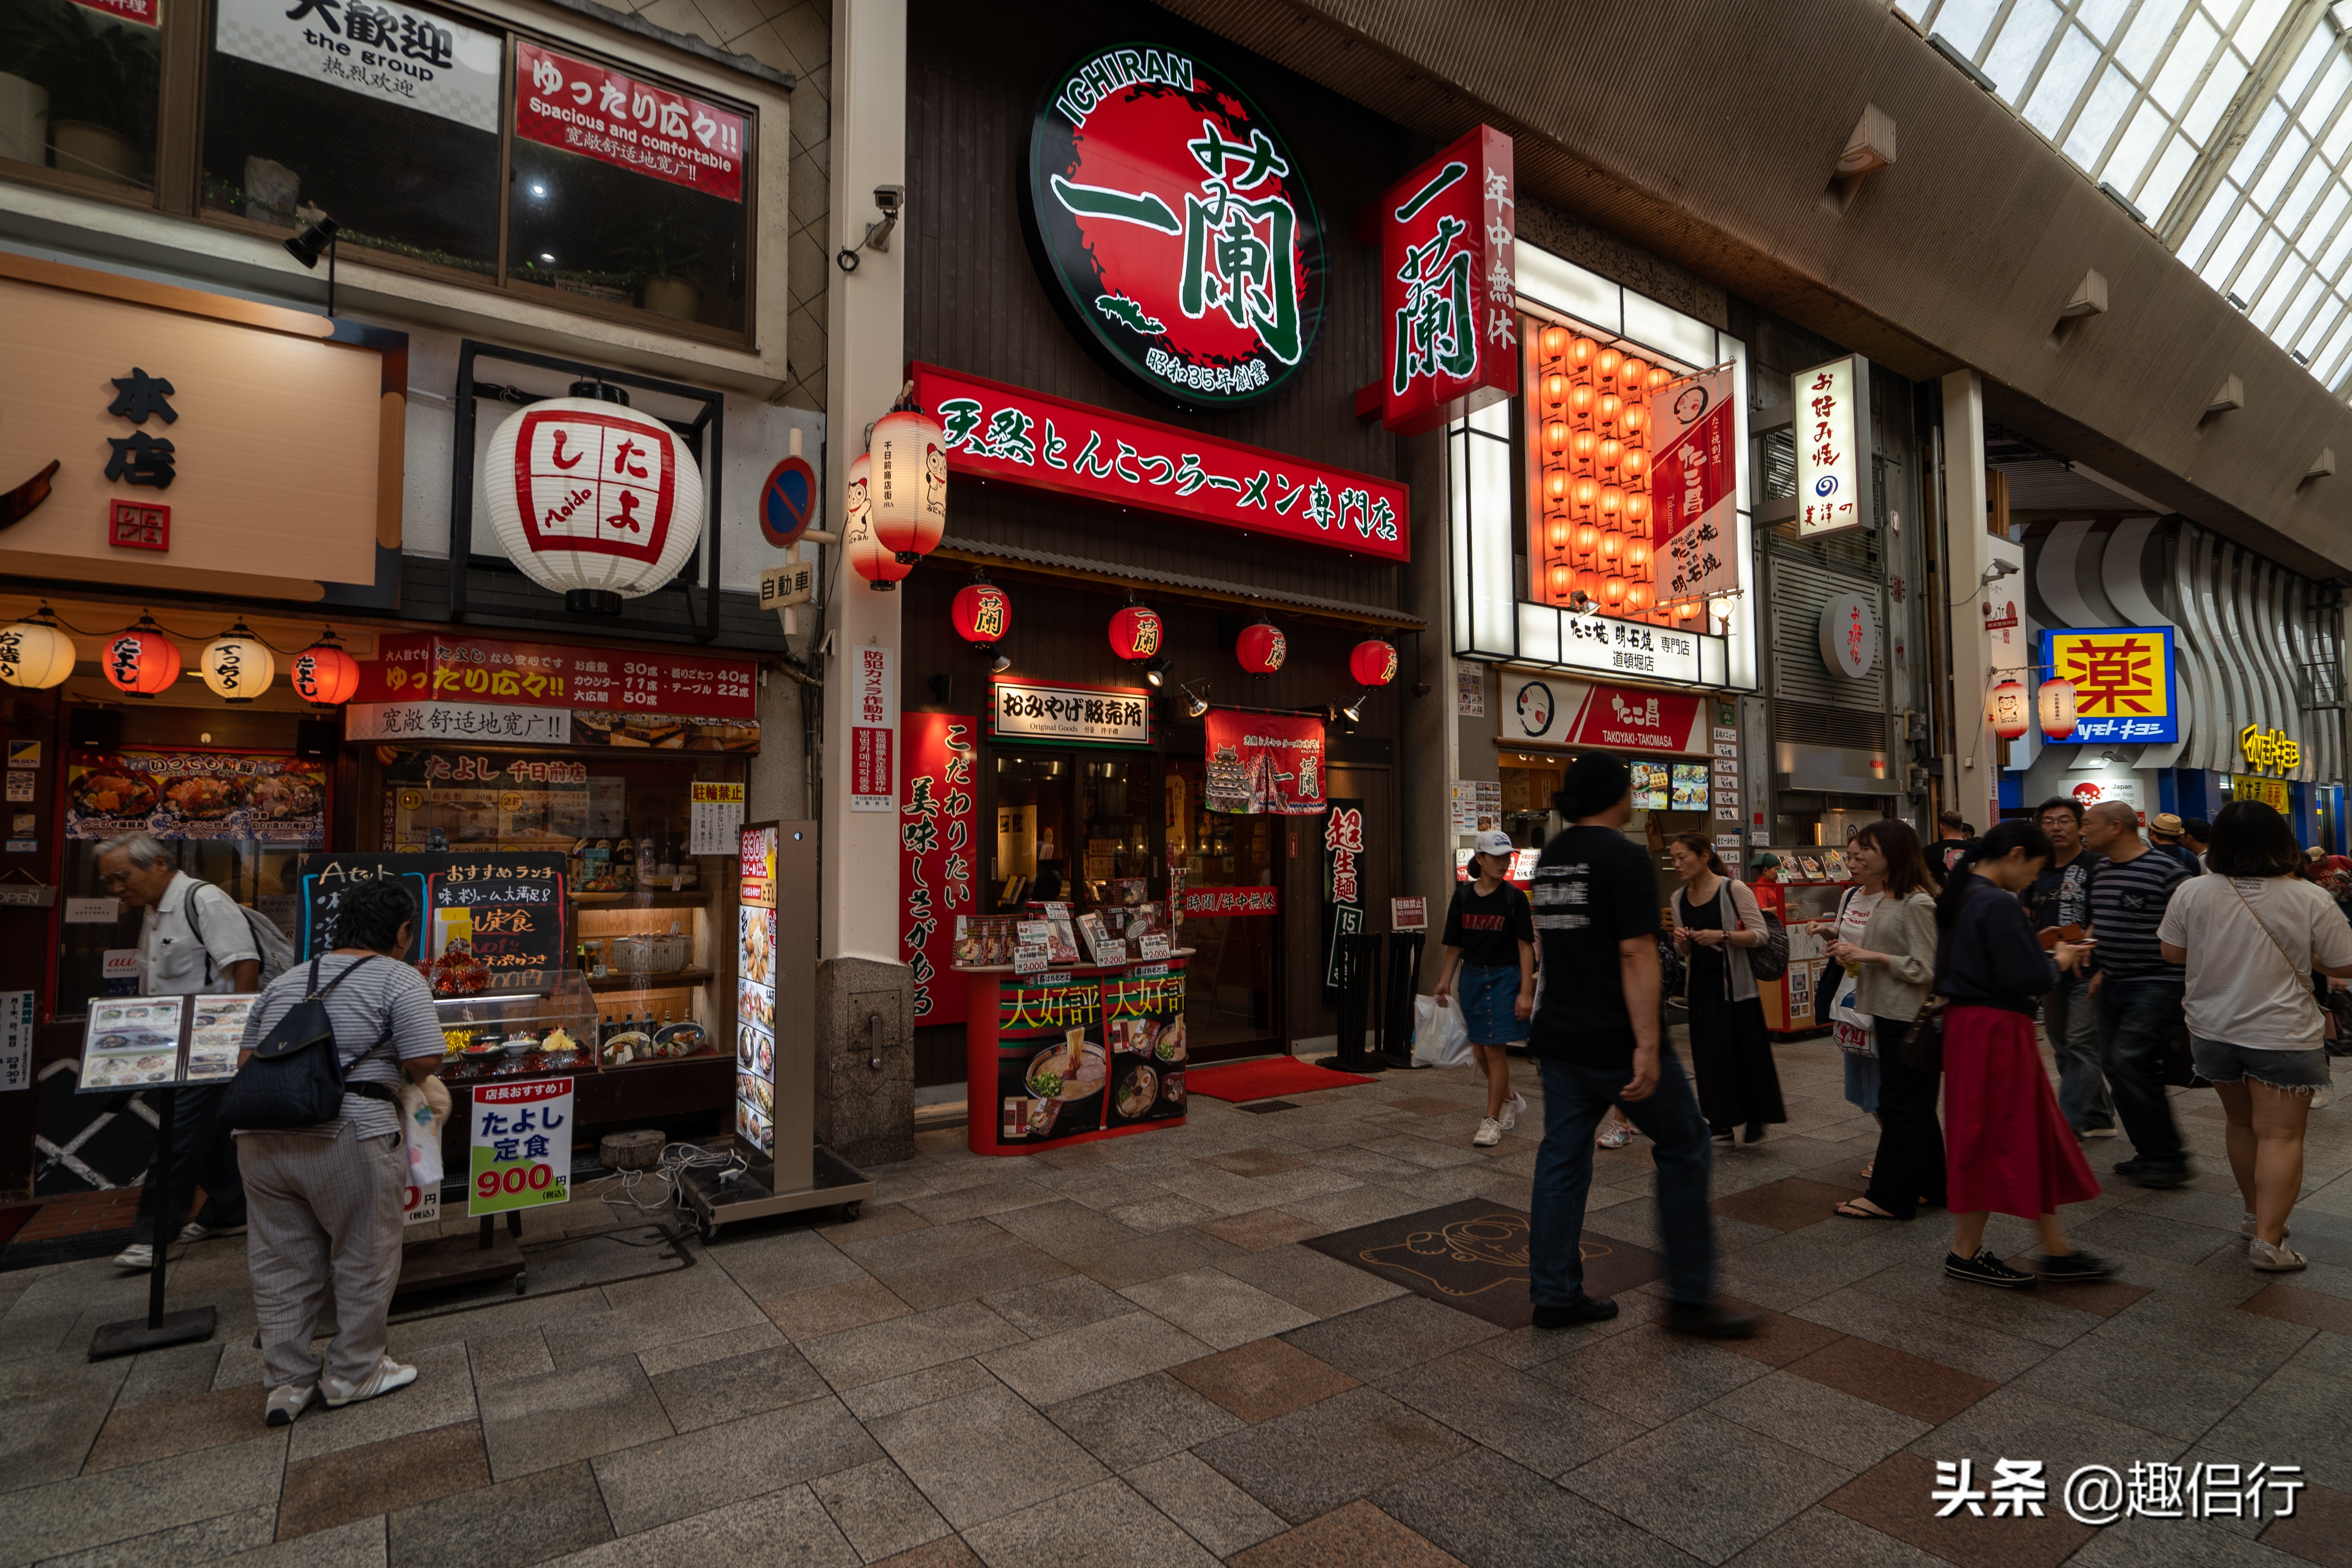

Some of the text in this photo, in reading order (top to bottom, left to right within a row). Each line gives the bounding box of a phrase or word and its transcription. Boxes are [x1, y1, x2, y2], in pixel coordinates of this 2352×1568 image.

[303, 28, 434, 81] the group
[322, 55, 416, 99] 热烈欢迎
[1057, 50, 1193, 128] ICHIRAN
[530, 97, 731, 172] Spacious and comfortable
[1051, 119, 1301, 365] 一蘭
[1485, 166, 1516, 350] 年中無休
[1394, 162, 1477, 396] 一蘭
[1147, 347, 1270, 394] 昭和35年創業
[105, 367, 178, 489] 本店
[884, 441, 892, 500] 千日前商店街
[937, 398, 1398, 540] 天然とんこつラーメン専門店
[1678, 443, 1707, 517] たこ昌
[545, 488, 591, 528] Maido
[762, 570, 808, 600] 自動車
[975, 587, 1003, 636] 一蘭
[1133, 609, 1158, 655] 一蘭
[1265, 628, 1286, 670] 一蘭
[1661, 636, 1690, 656] 専門店
[112, 638, 141, 684] たよし
[386, 646, 563, 668] 大人数でも たよし なら安心です
[575, 660, 608, 673] お座敷
[624, 662, 658, 677] 30席
[717, 670, 750, 684] 40席
[1613, 651, 1654, 673] 道頓堀店
[295, 655, 317, 697] たよし
[387, 665, 564, 698] ゆったり広々!!
[574, 675, 749, 698] カウンター 11席 テーブル 22席
[864, 651, 883, 723] 防犯カメラ作動中
[2067, 639, 2152, 713] 薬
[574, 690, 657, 706] 大広間 50席
[1003, 693, 1143, 727] おみやげ販売所
[1612, 693, 1659, 728] たこ昌
[1030, 722, 1056, 732] Original
[2070, 720, 2164, 740] ツモトキヨシ
[149, 757, 257, 777] いつでも新鮮
[425, 755, 587, 784] たよし 千日前店
[1273, 756, 1318, 799] 一蘭
[404, 796, 418, 805] B1
[693, 784, 742, 800] 駐輪禁止
[944, 724, 971, 910] こだわりたい
[447, 865, 556, 882] おすすめ ランチ
[902, 775, 940, 1017] 美味しさがある
[1169, 892, 1275, 912] 時間/年中無休
[1396, 899, 1422, 910] 駐輪禁止
[472, 909, 535, 932] し定食
[108, 958, 136, 967] au
[1001, 984, 1101, 1031] 大好評
[1107, 975, 1186, 1021] 大好評
[486, 1083, 563, 1100] 店長おすすめ!
[482, 1107, 563, 1137] たよし
[492, 1134, 550, 1163] 定食
[477, 1164, 566, 1199] 900円
[543, 1191, 565, 1200] (税込)
[410, 1209, 434, 1220] (税込)
